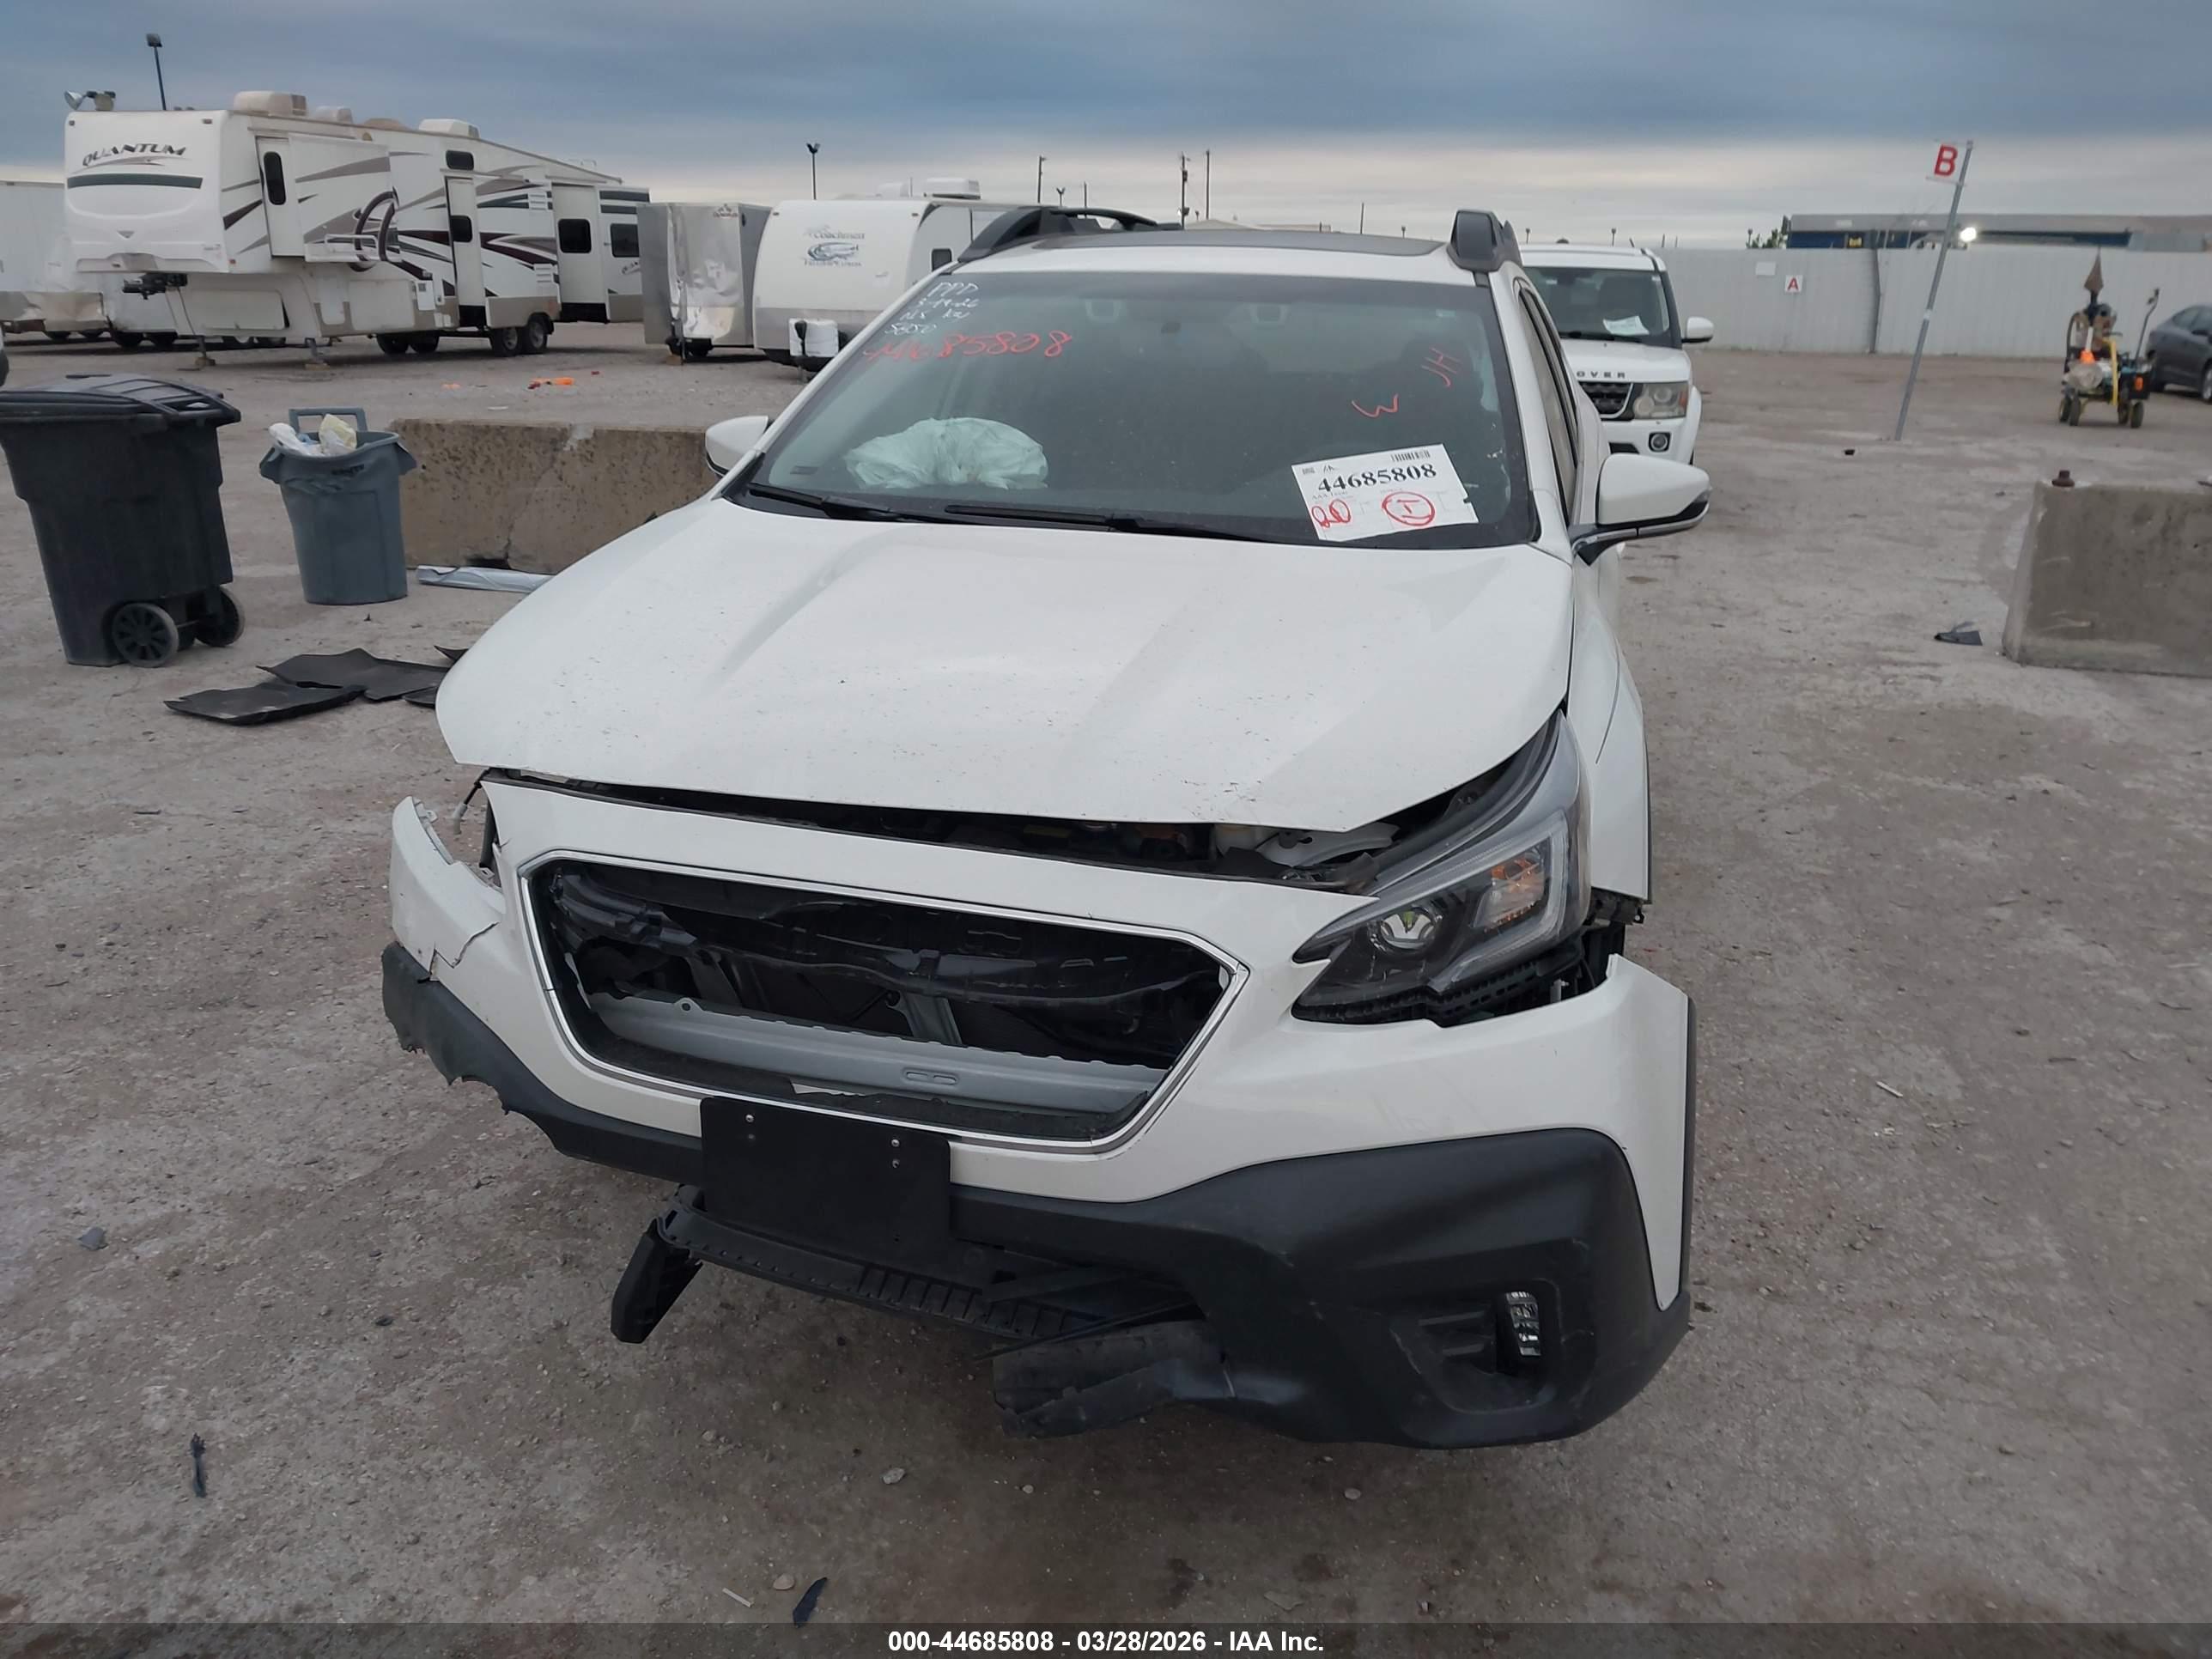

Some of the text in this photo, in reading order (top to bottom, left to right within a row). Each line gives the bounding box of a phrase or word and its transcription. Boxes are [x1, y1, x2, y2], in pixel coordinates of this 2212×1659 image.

[82, 143, 186, 167] QUANTUM
[1934, 143, 1958, 177] B
[1787, 276, 1800, 290] A
[1576, 370, 1626, 379] OVER
[1317, 462, 1437, 493] 44685808
